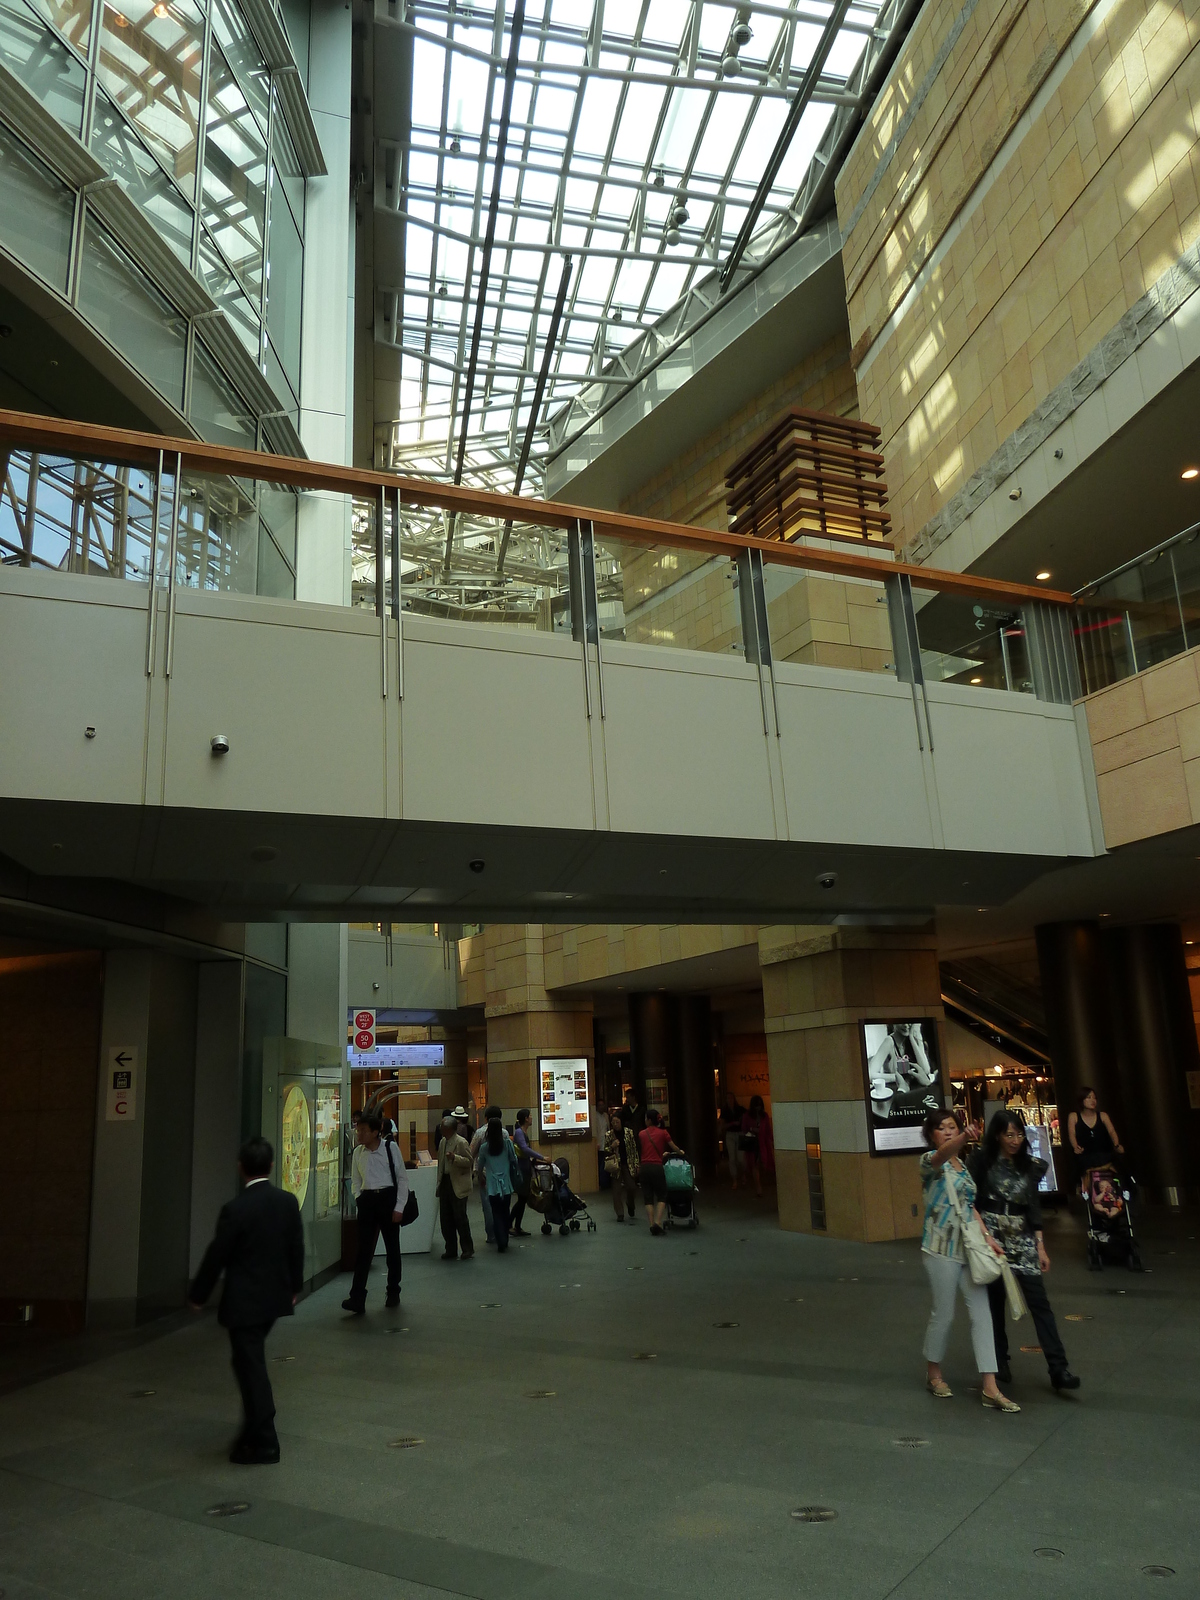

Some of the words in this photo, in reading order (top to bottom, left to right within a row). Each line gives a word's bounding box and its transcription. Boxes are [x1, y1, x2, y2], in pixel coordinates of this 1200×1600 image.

[360, 1034, 369, 1042] 50
[115, 1101, 128, 1115] C
[889, 1109, 903, 1117] STAR
